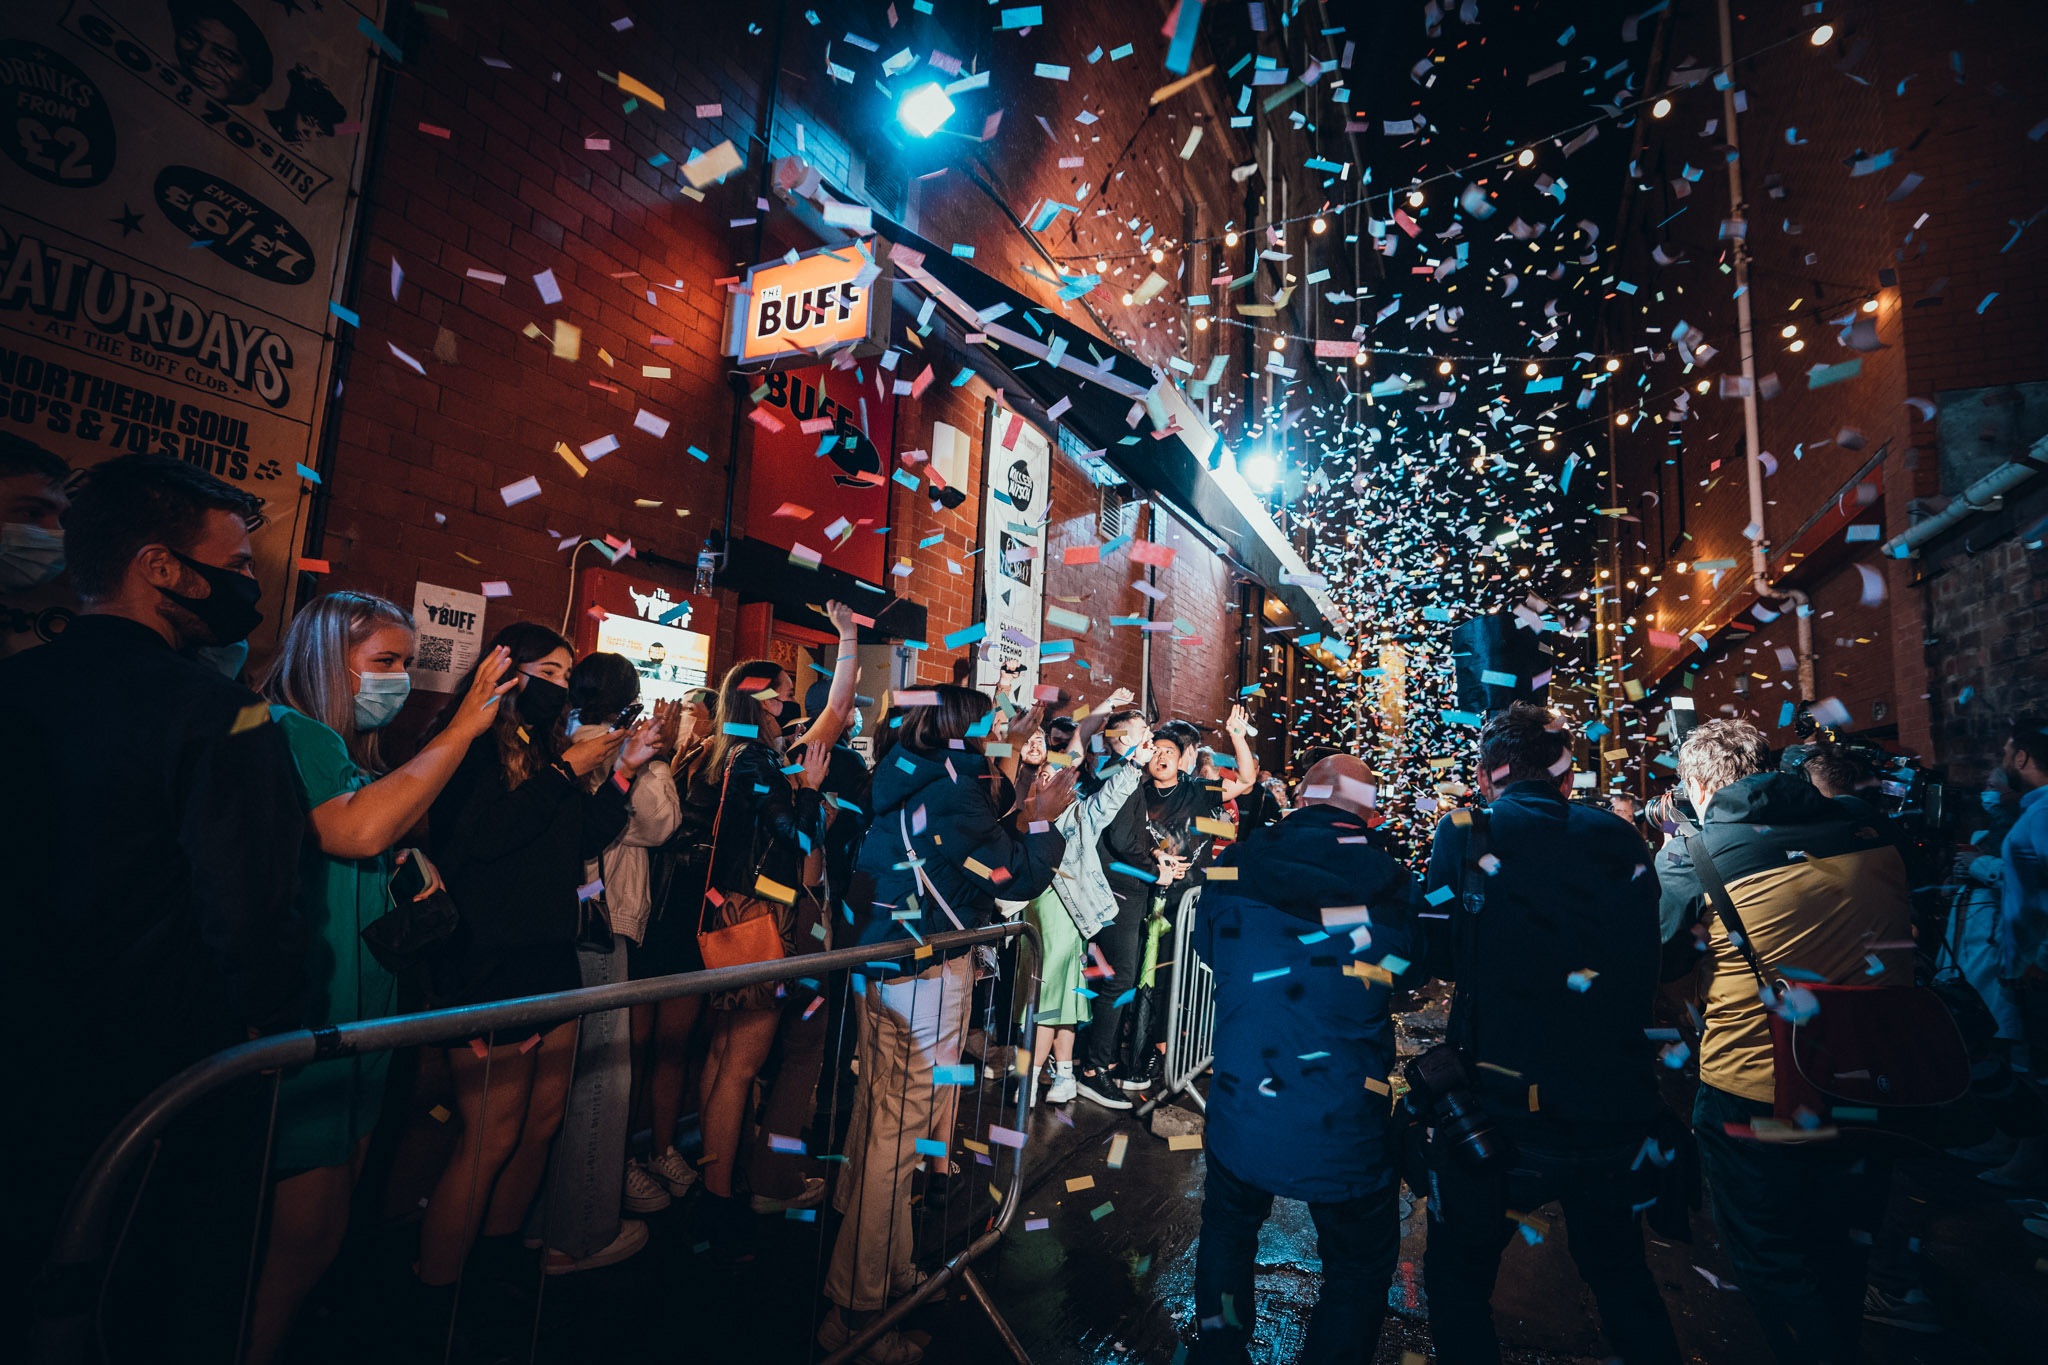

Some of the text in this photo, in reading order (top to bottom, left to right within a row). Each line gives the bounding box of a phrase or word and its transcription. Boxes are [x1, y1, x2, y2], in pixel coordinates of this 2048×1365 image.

[0, 57, 95, 110] DRINKS
[17, 90, 77, 123] FROM
[16, 116, 93, 179] £2
[176, 84, 193, 106] &
[272, 154, 314, 195] HITS
[203, 184, 260, 217] ENTRY
[0, 224, 294, 409] ATURDAYS
[758, 282, 859, 336] BUFF
[44, 320, 229, 394] AT THE BUFF CLUB
[0, 347, 251, 452] NORTHERN SOUL
[76, 409, 105, 441] &
[184, 437, 250, 481] HITS
[438, 608, 476, 630] BUFF
[1000, 643, 1023, 658] TECHNO
